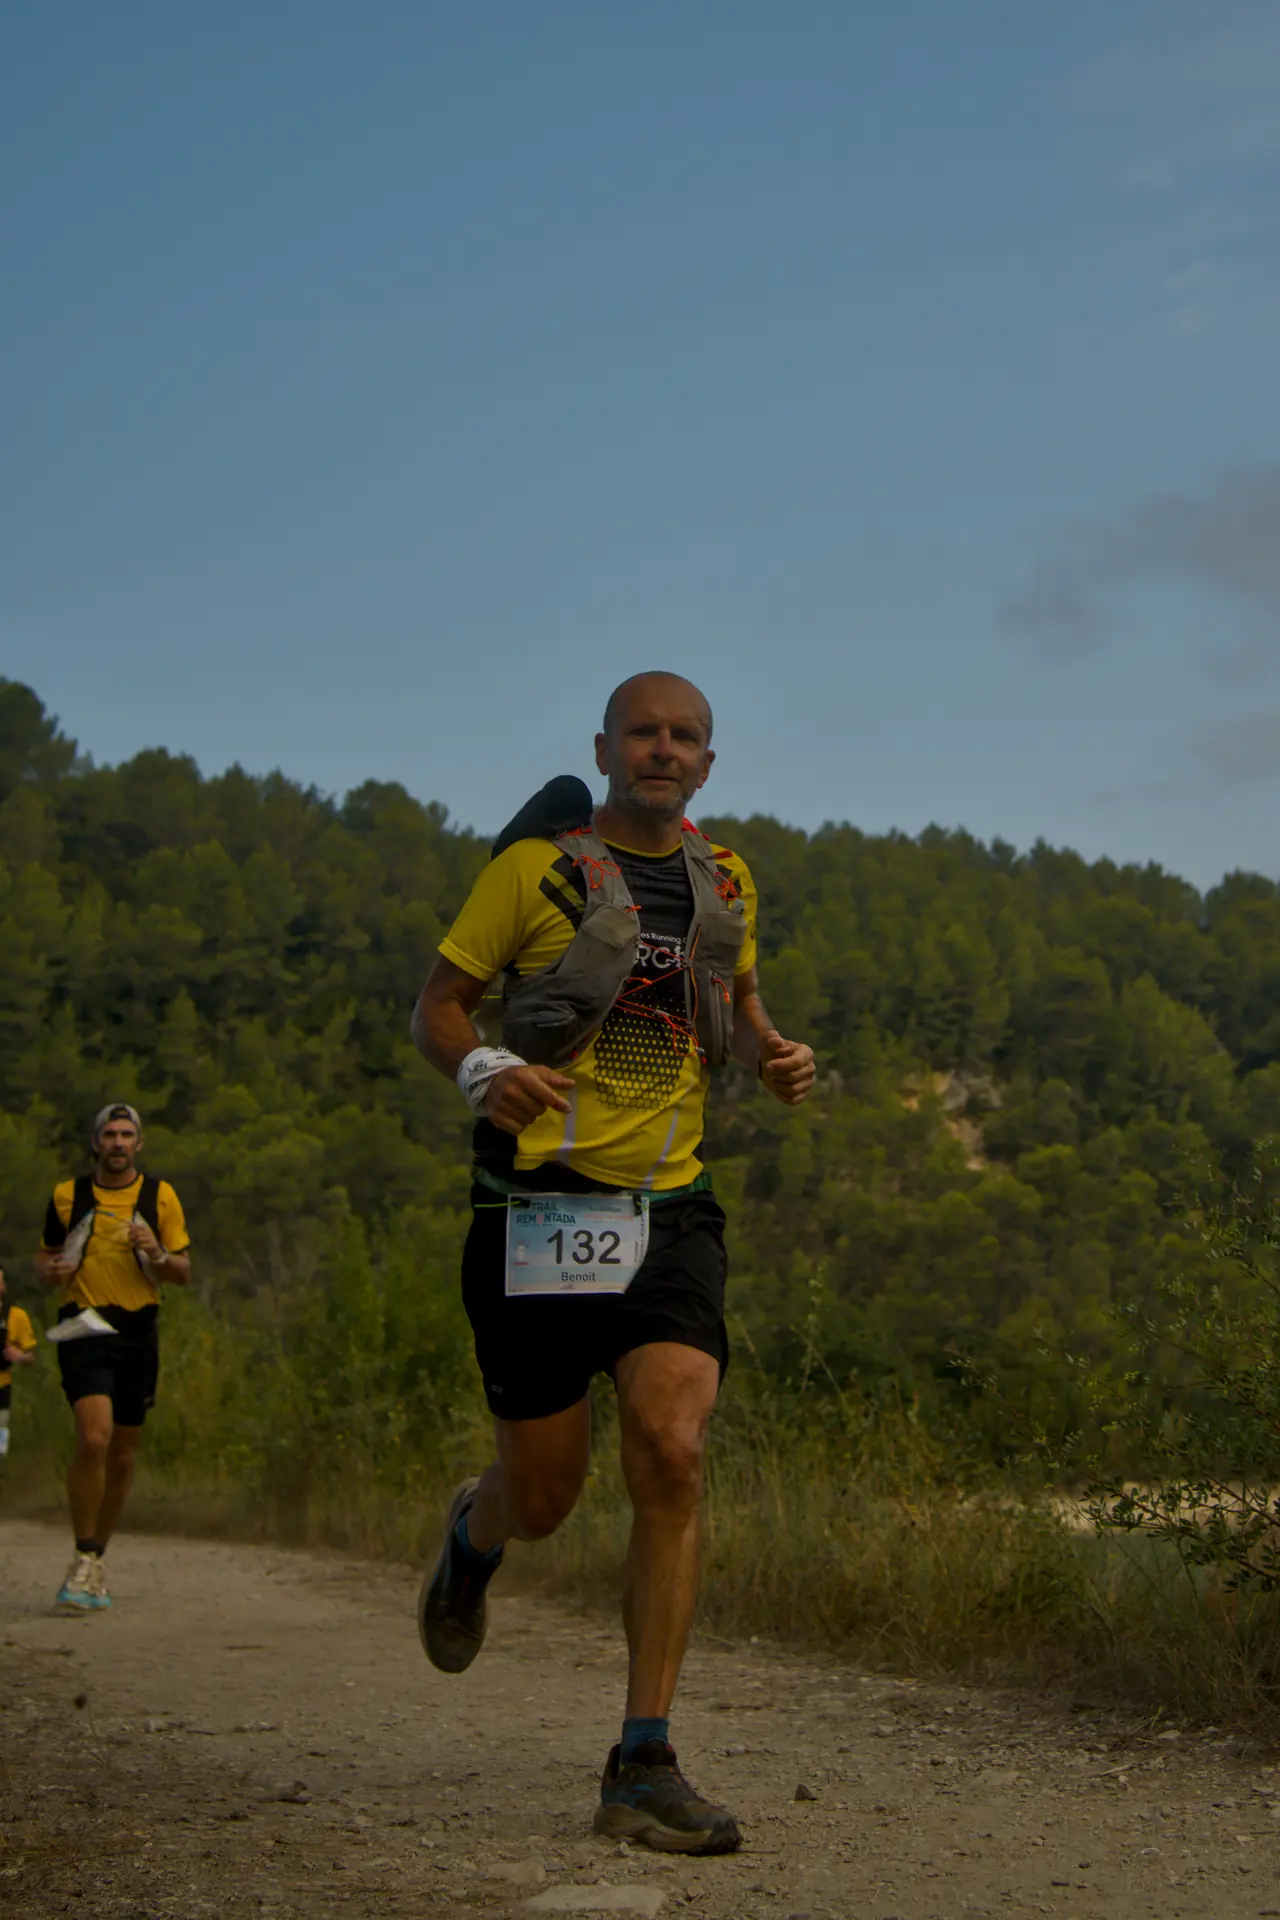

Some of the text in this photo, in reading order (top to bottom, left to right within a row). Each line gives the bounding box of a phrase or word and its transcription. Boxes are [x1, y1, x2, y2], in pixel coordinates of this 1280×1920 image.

[651, 932, 682, 945] Running
[531, 1201, 559, 1213] TRAIL
[547, 1228, 621, 1265] 132
[561, 1271, 596, 1282] Benoit
